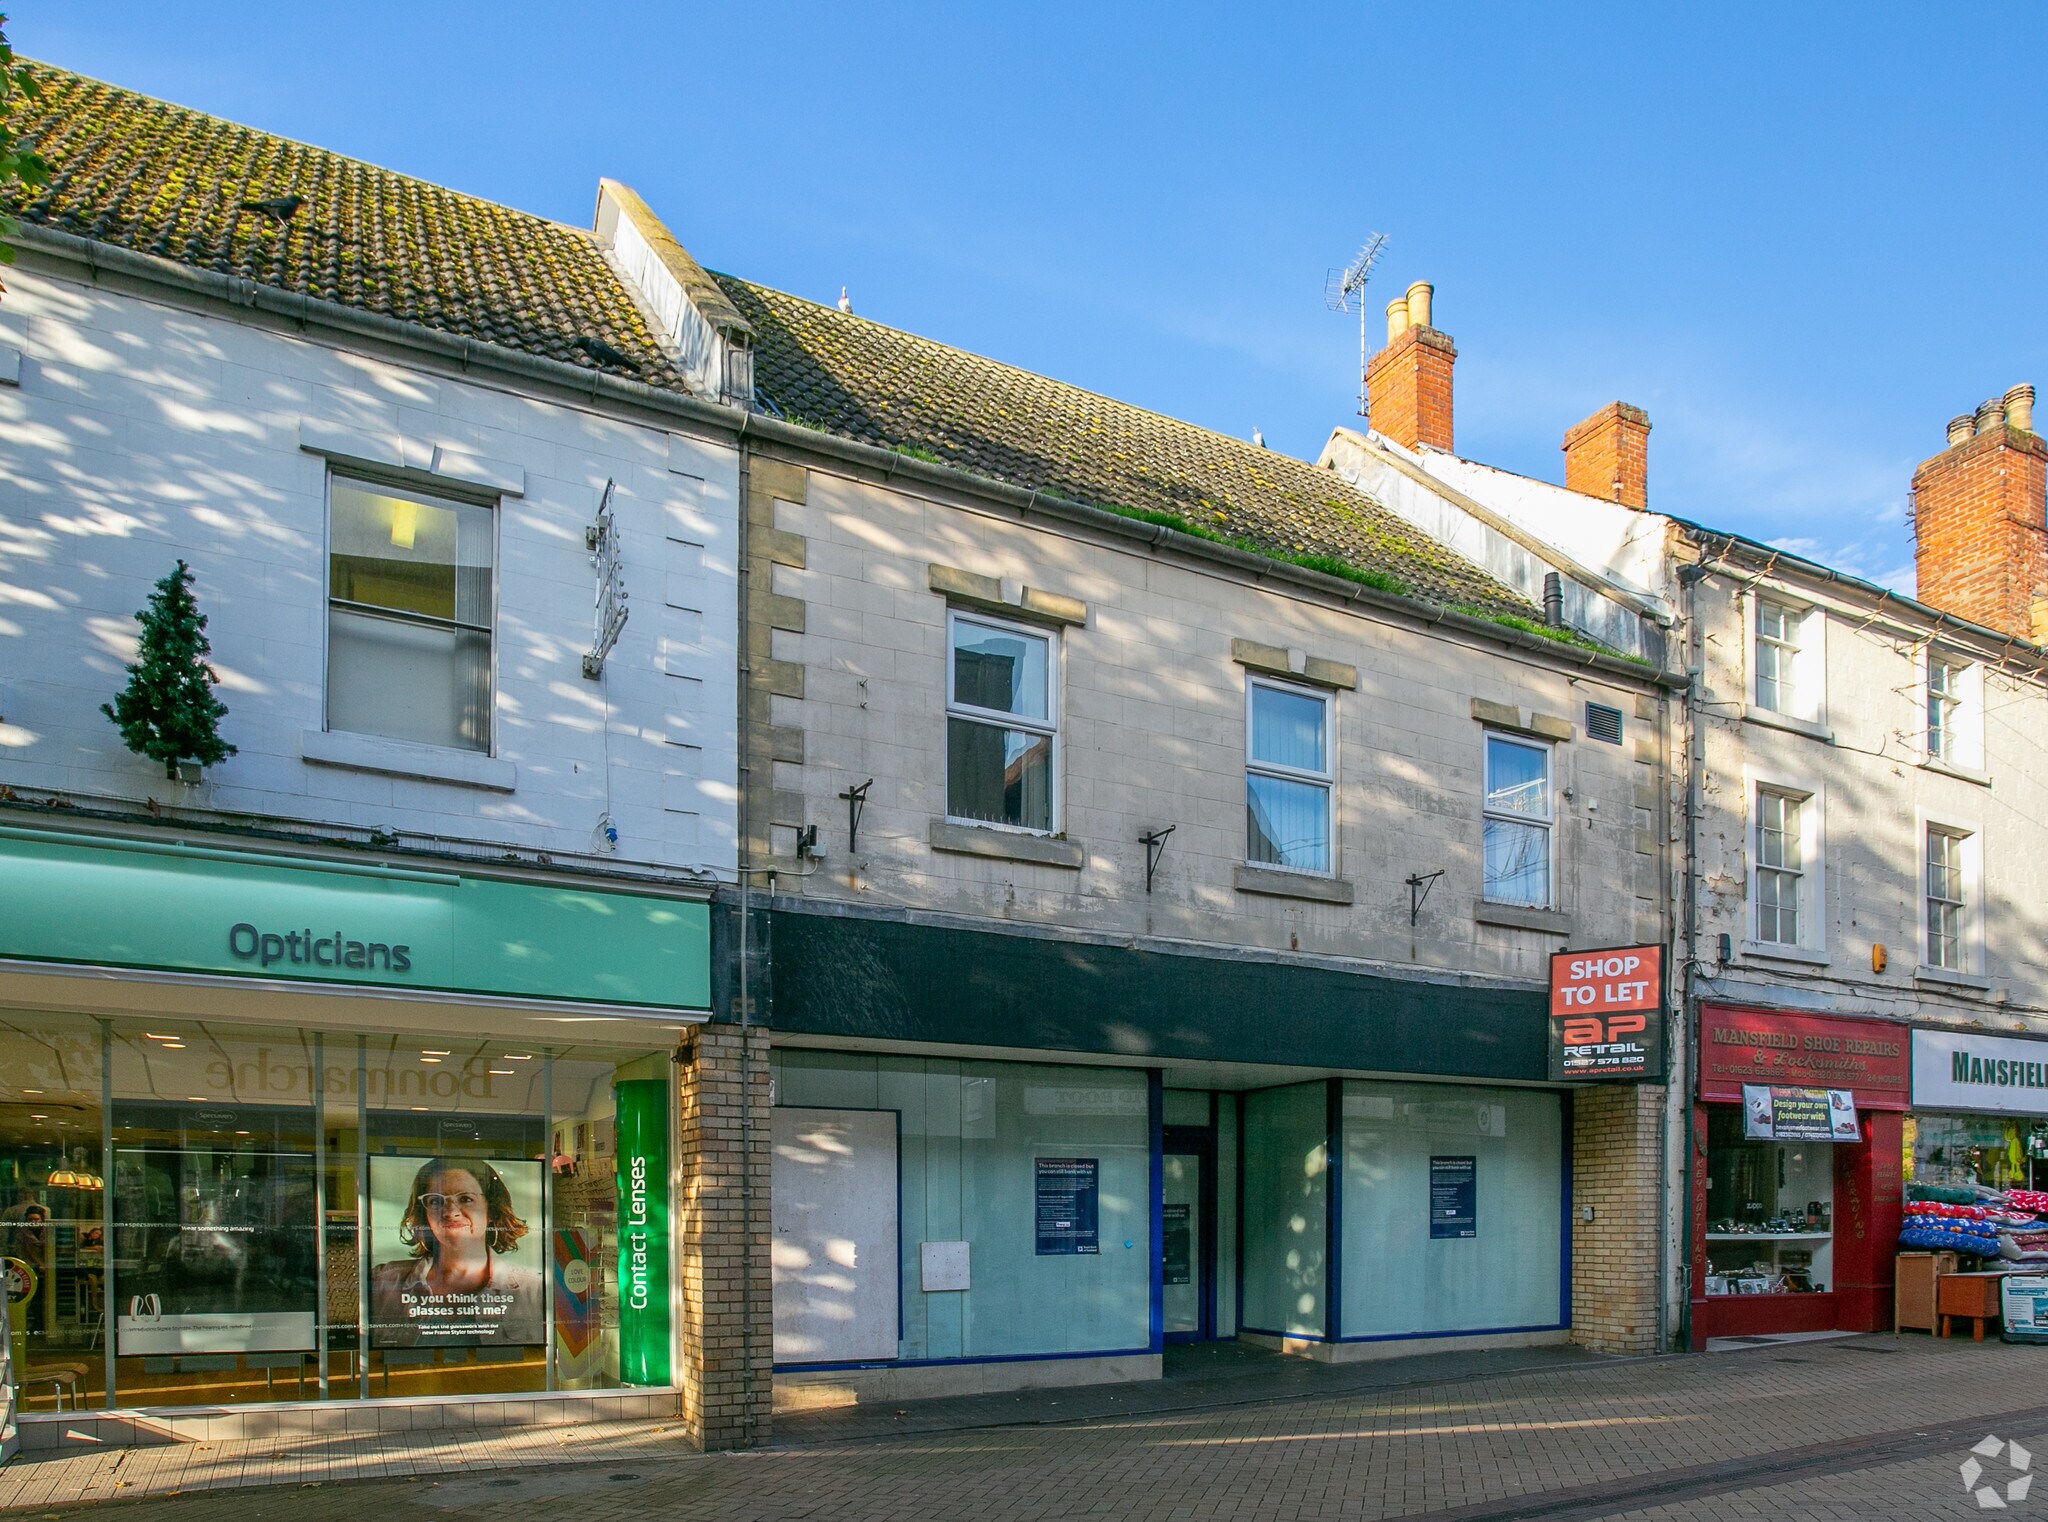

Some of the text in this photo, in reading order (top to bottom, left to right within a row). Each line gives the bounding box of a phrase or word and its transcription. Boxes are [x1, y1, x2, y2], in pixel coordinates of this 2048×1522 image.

[229, 922, 412, 972] Opticians
[1569, 956, 1640, 980] SHOP
[1560, 980, 1650, 1006] TO LET
[1712, 1027, 1900, 1058] MANSFIELD SHOE REPAIRS
[1597, 1057, 1620, 1065] 578
[1621, 1056, 1645, 1064] 820
[1753, 1050, 1867, 1072] & Locksmiths
[1563, 1065, 1645, 1075] www.apretail.co.uk
[1773, 1099, 1828, 1110] Design your own
[1777, 1110, 1826, 1121] footwear with
[1695, 1158, 1704, 1264] KEY CUTTING
[197, 1225, 229, 1233] something
[629, 1155, 647, 1310] Contact Lenses
[568, 1276, 587, 1284] COLOUR
[401, 1293, 514, 1305] Do you think these
[409, 1304, 508, 1317] glasses suit me?
